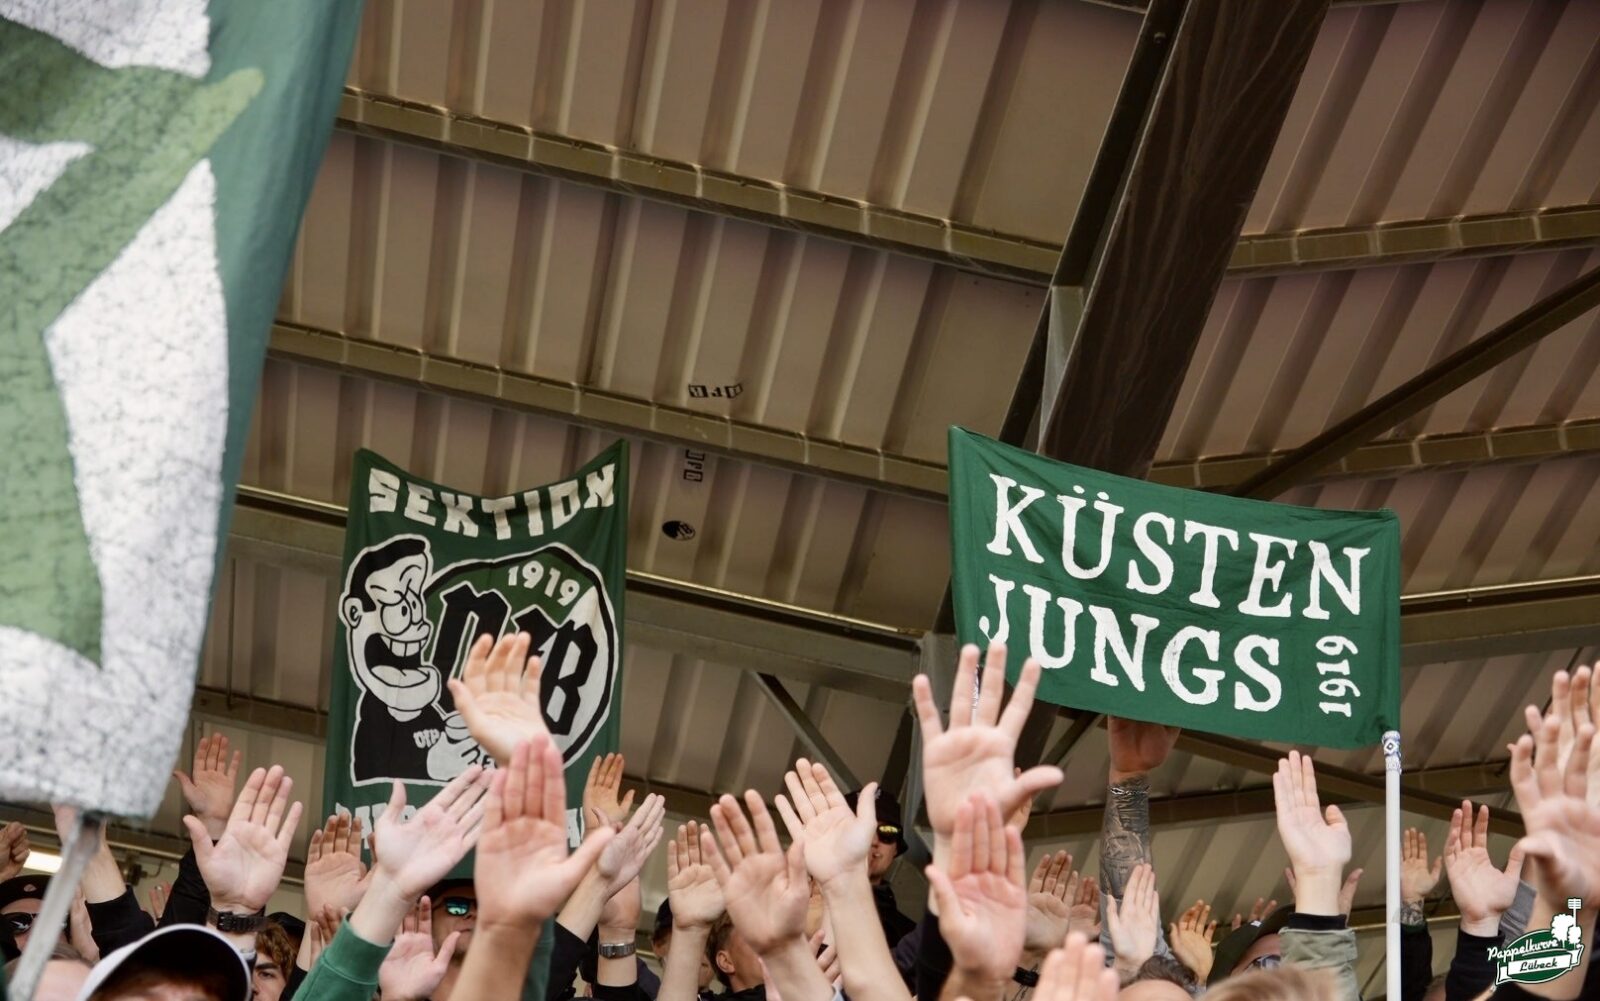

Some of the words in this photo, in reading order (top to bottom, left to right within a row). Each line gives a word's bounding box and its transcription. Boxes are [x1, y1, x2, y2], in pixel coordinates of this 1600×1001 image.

[368, 463, 615, 540] SEKTION
[508, 560, 580, 607] 1919
[986, 473, 1371, 620] KÜSTEN
[979, 574, 1282, 712] JUNGS
[1316, 635, 1361, 718] 1919
